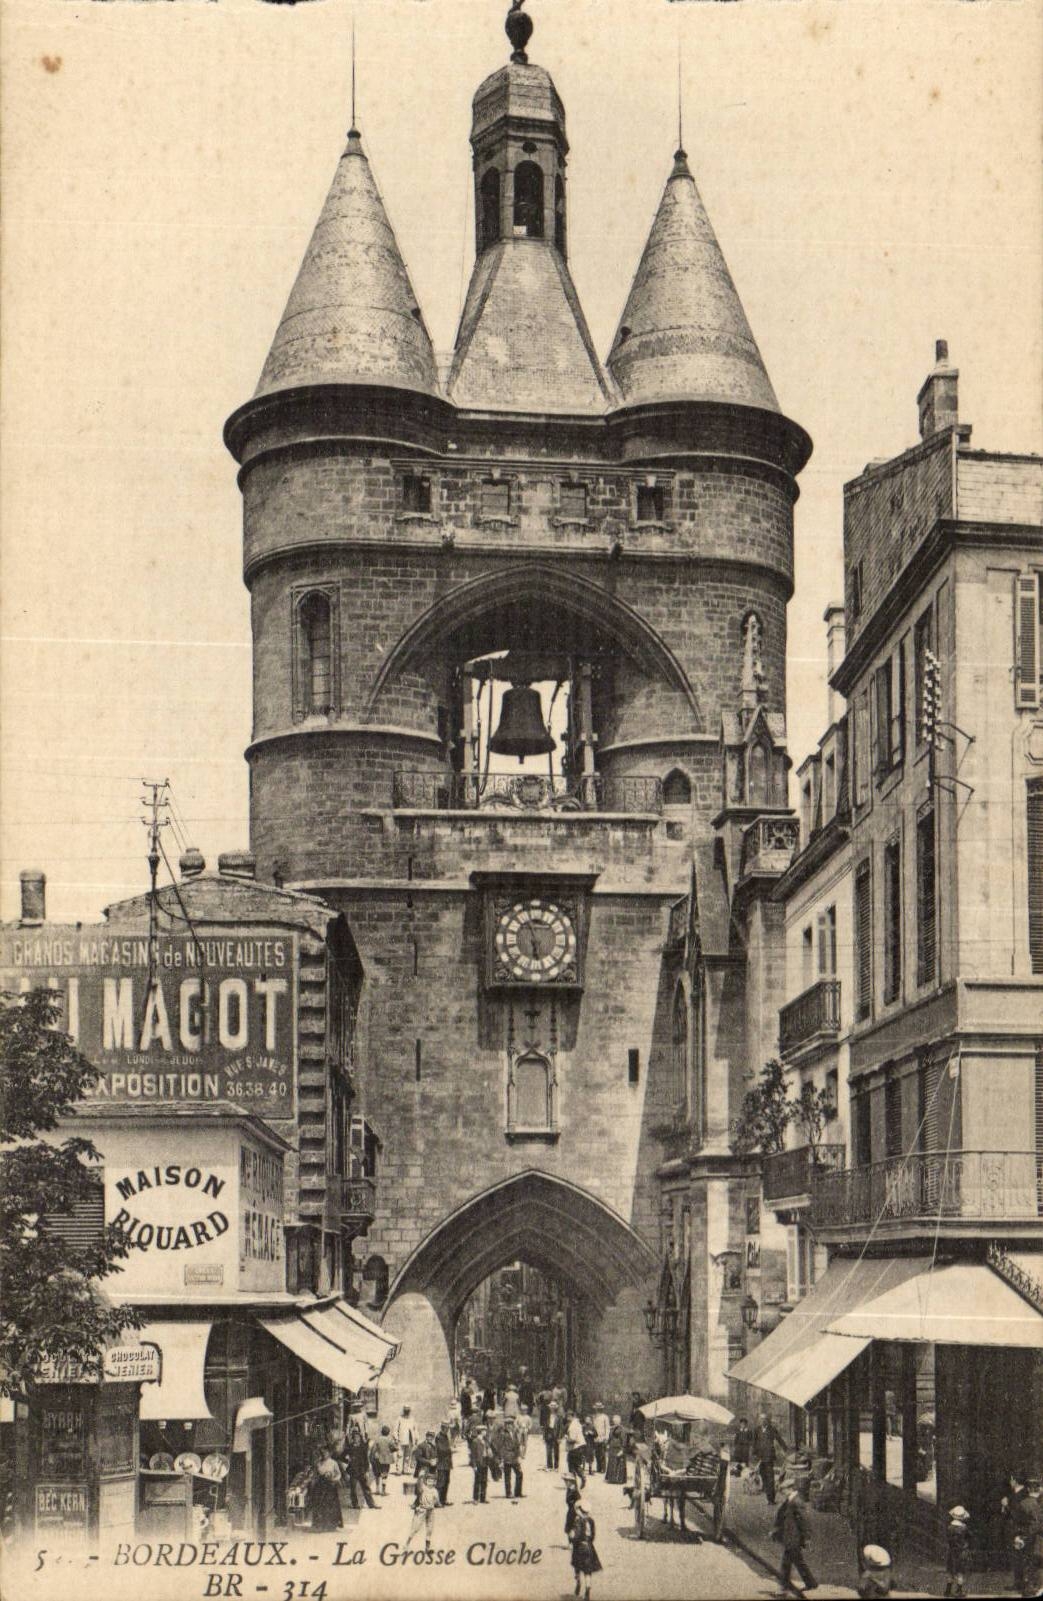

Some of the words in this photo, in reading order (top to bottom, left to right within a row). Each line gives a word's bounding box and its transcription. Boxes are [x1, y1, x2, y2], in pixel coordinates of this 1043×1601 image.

[13, 941, 73, 965] GRANDS
[163, 944, 182, 967] de
[103, 976, 289, 1052] MAGOT
[115, 1165, 226, 1201] MAISON
[111, 1349, 155, 1363] CHOCOLAT
